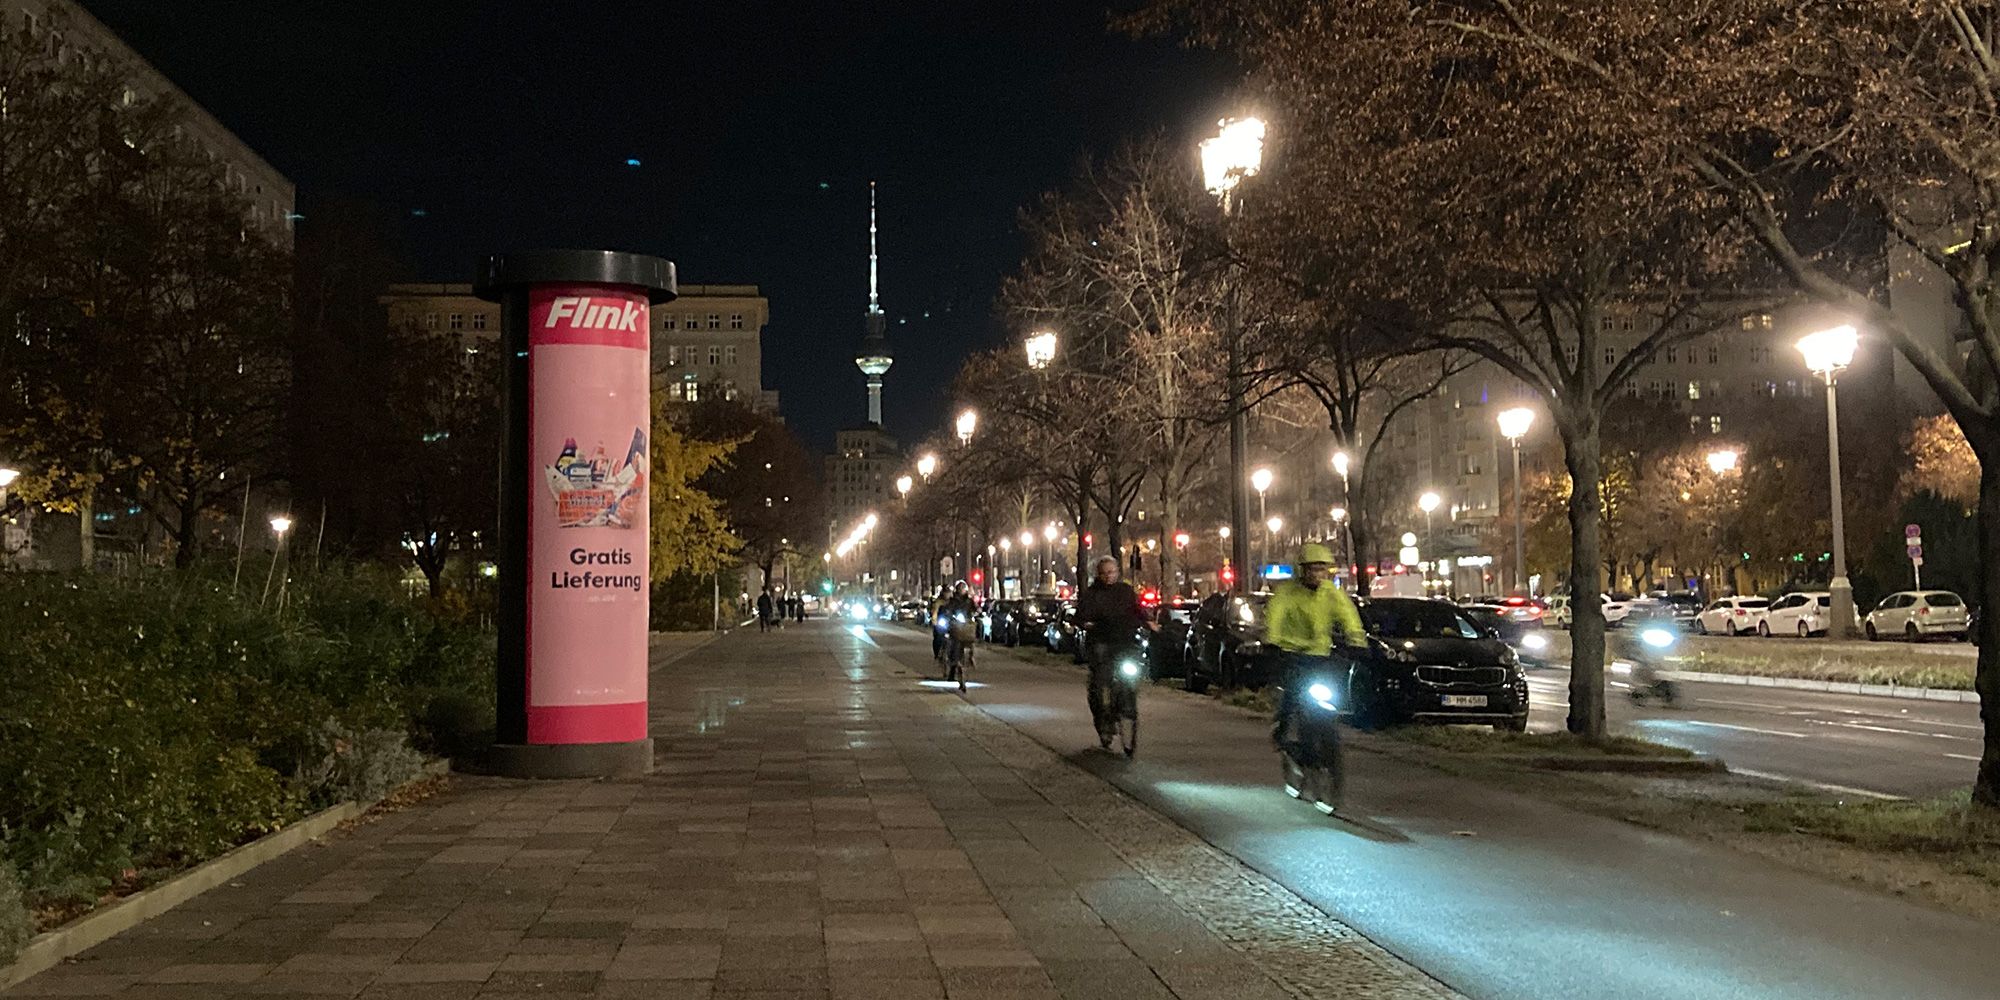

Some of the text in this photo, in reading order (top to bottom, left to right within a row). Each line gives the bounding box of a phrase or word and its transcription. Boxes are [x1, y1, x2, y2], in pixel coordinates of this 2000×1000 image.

[545, 297, 639, 332] Flink
[570, 548, 632, 565] Gratis
[551, 571, 641, 592] Lieferung
